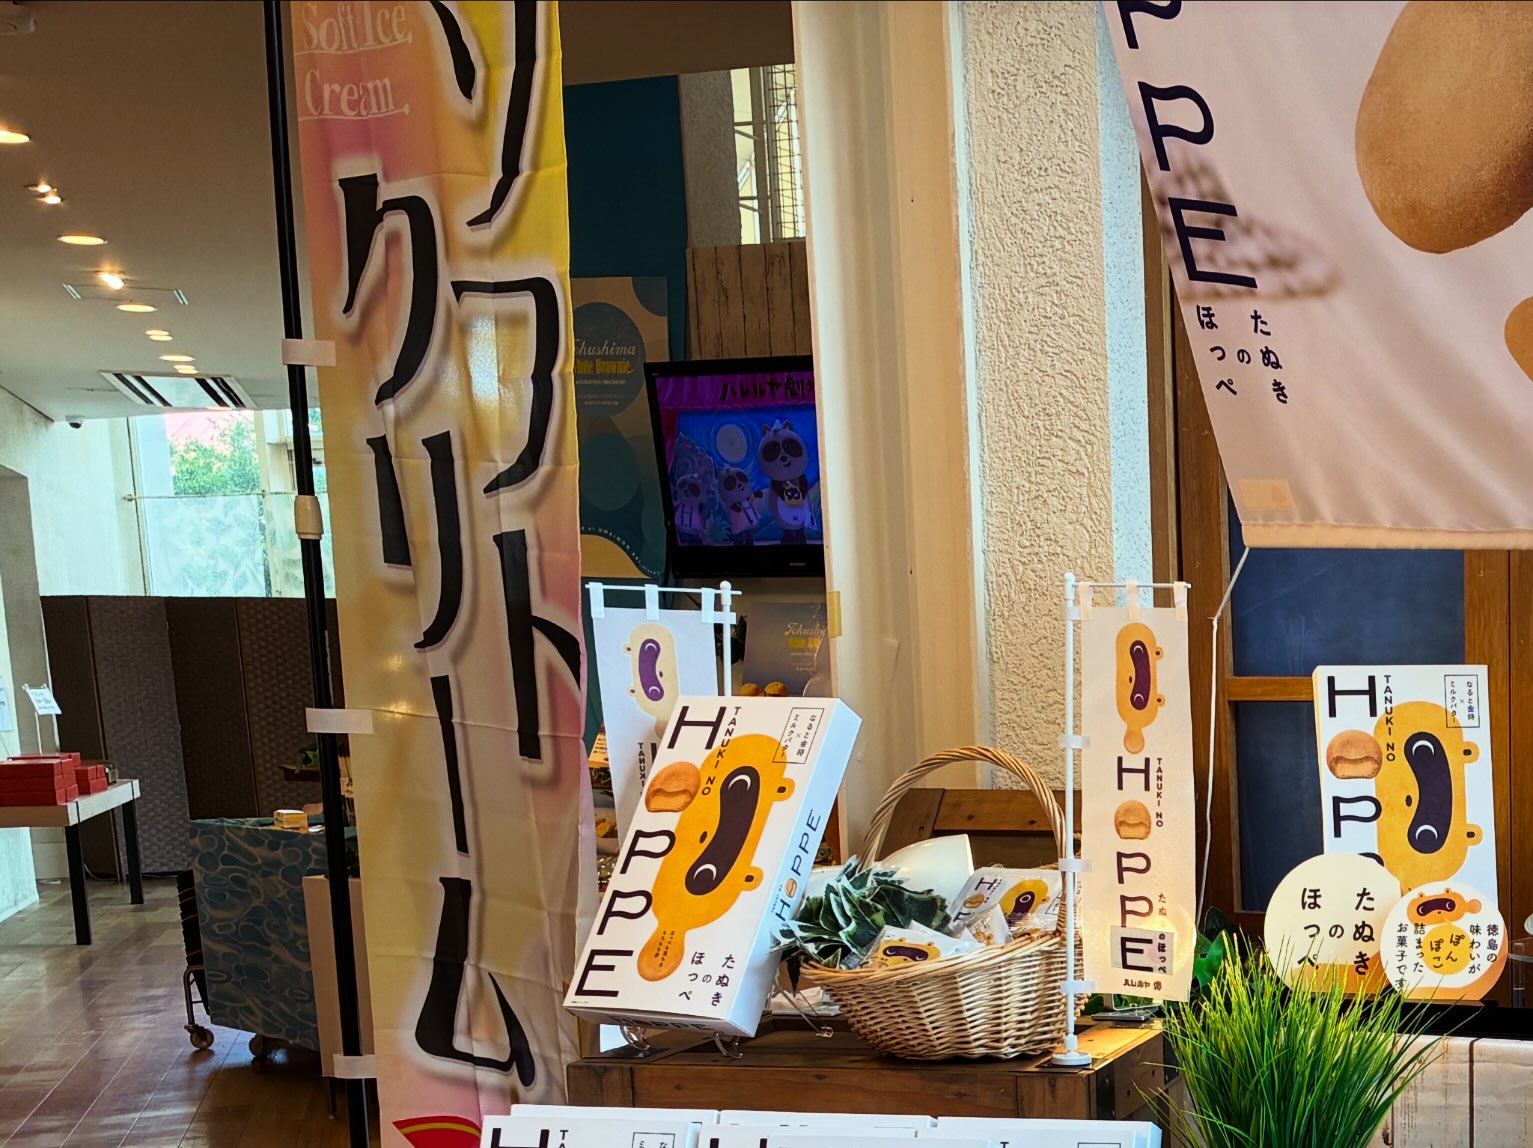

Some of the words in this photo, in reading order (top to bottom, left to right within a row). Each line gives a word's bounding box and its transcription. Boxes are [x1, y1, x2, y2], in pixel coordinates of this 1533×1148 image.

[305, 68, 395, 116] Cream
[1250, 309, 1289, 405] たぬき
[337, 173, 536, 1088] クリーム
[711, 706, 743, 770] TANUKI
[779, 713, 801, 758] ミルクバター
[794, 713, 817, 760] なると金時
[1328, 922, 1345, 940] の
[1352, 887, 1376, 976] たぬき
[1412, 922, 1427, 974] 詰まった
[1468, 923, 1482, 975] 味わいが
[1486, 923, 1500, 963] 徳島の
